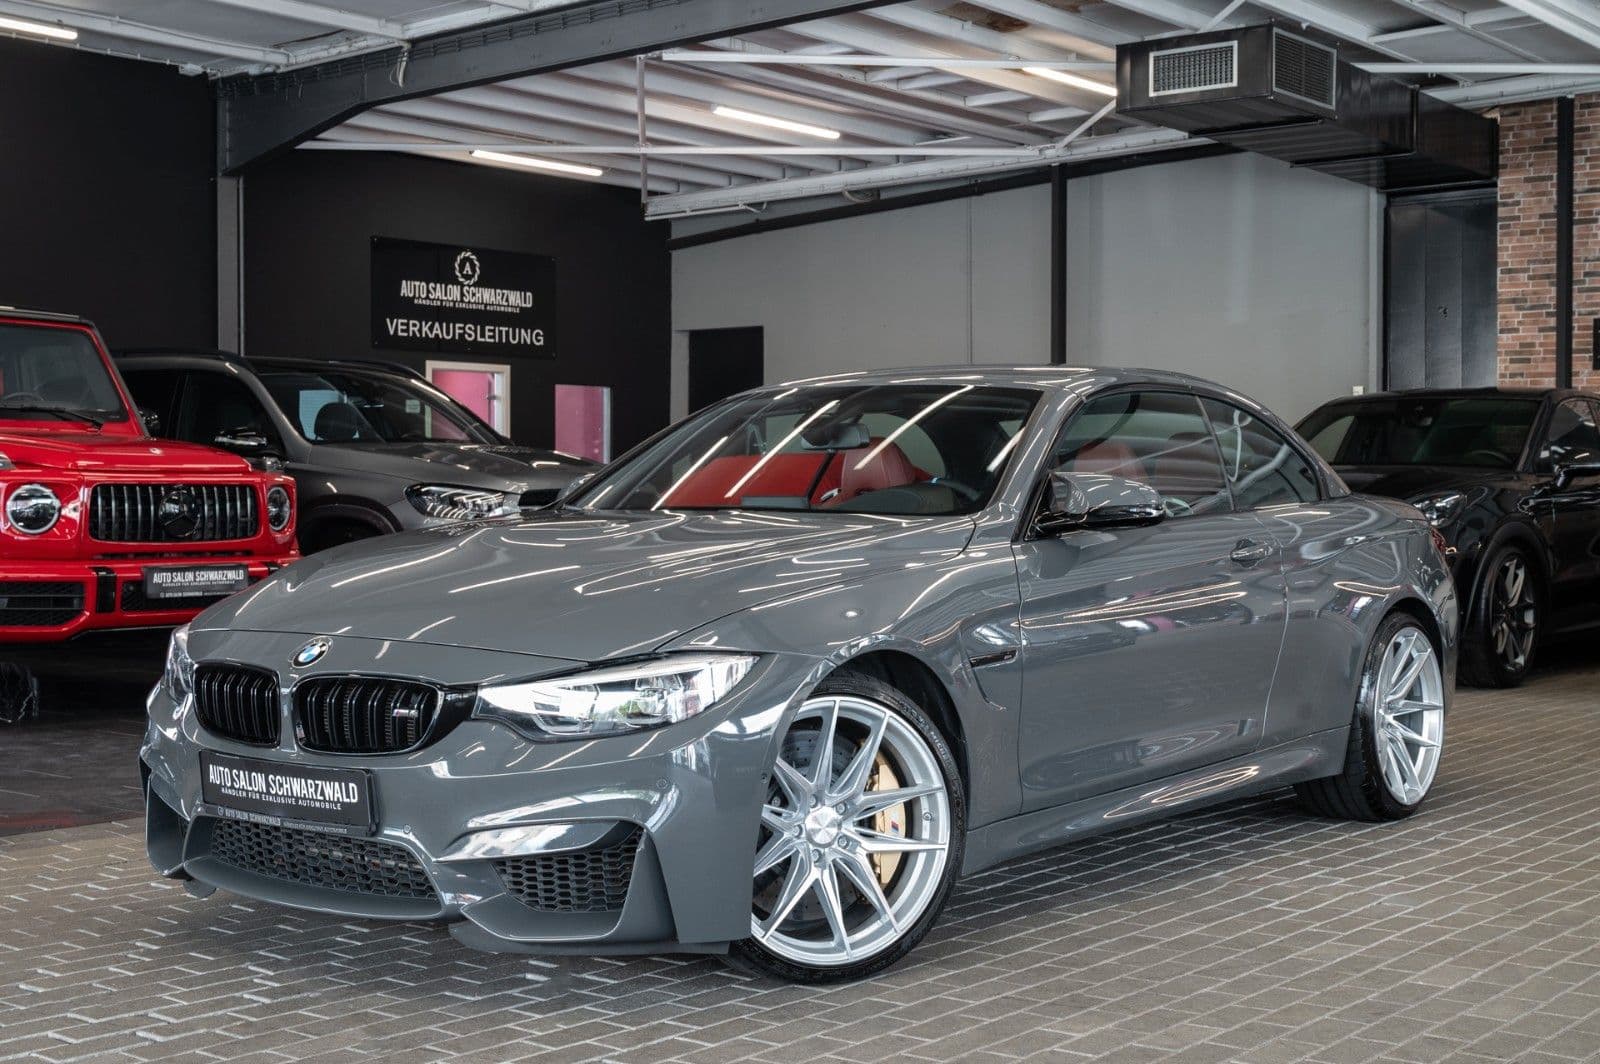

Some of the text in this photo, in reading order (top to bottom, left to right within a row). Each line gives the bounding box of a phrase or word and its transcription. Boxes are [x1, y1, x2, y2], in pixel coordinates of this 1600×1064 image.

[463, 261, 473, 275] A
[400, 280, 533, 308] AUTO SALON SCHWARZWALD
[386, 318, 544, 345] VERKAUFSLEITUNG
[153, 570, 244, 584] AUTO SALON SCHWARZWALD
[209, 764, 359, 804] AUTO SALON SCHWARZWALD
[221, 786, 342, 811] HÄNDLER FÜR EXKLUSIVE AUTOMOBILE
